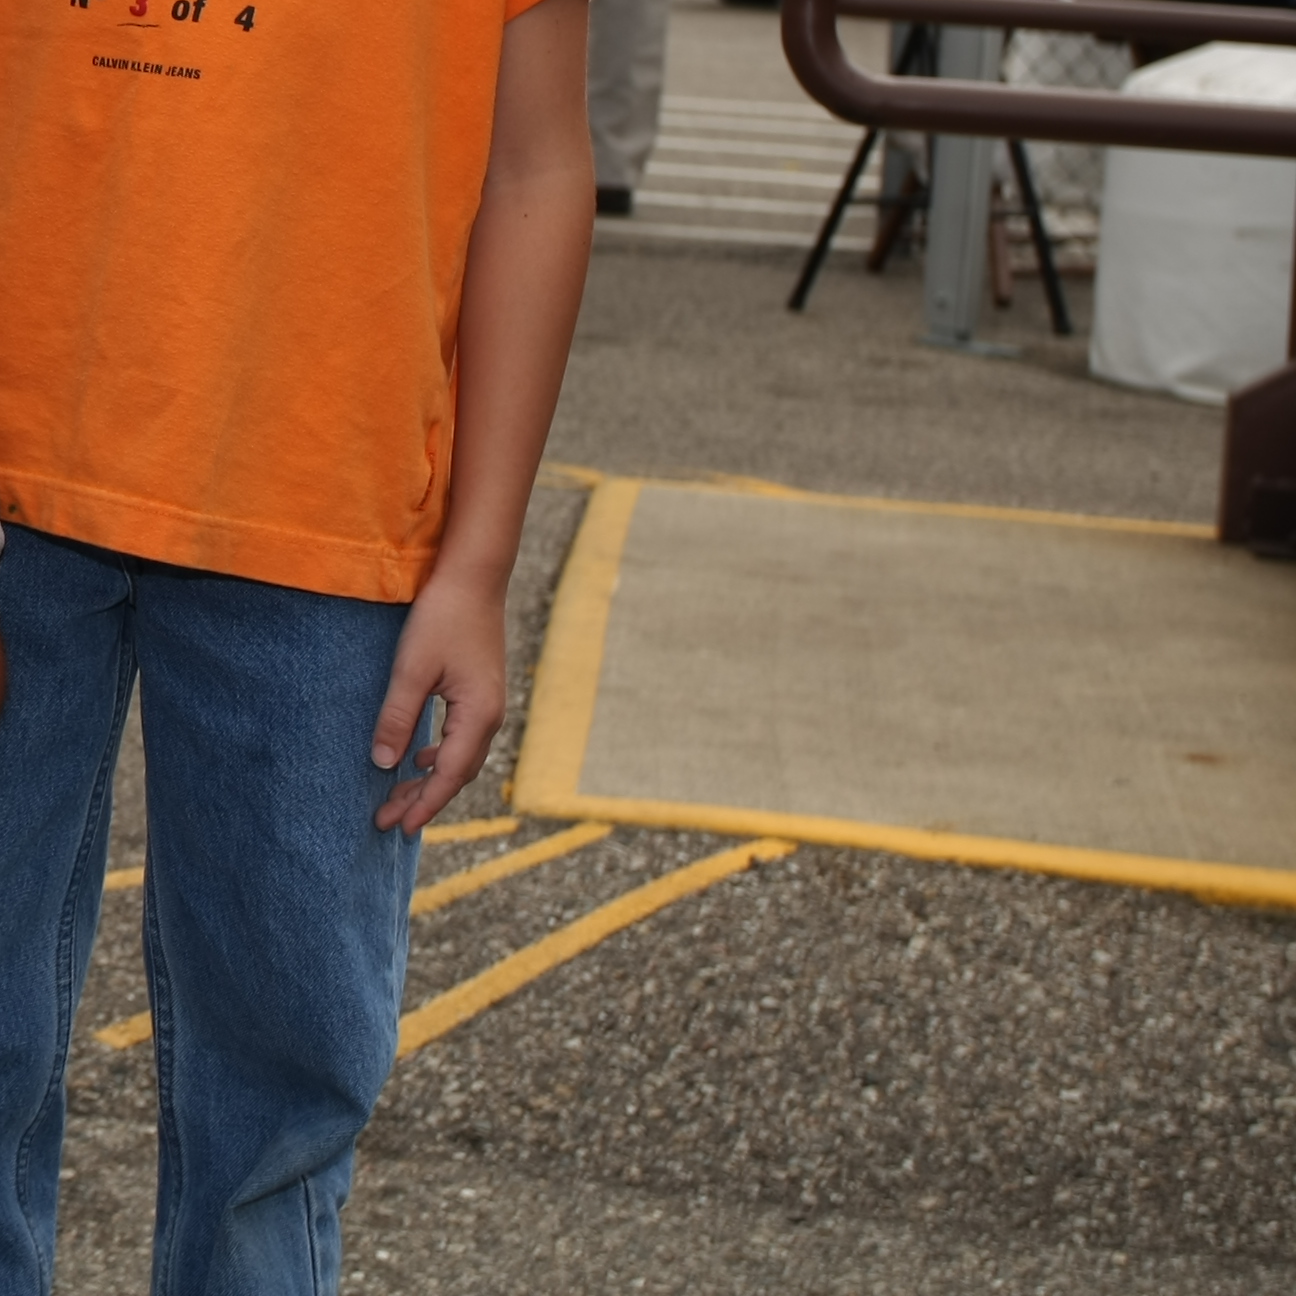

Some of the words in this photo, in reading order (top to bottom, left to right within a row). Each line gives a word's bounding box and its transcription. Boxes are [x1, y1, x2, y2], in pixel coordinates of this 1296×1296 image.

[234, 5, 256, 32] 4
[92, 55, 129, 70] CALVIN
[130, 61, 163, 75] KLEIN
[165, 66, 201, 80] JEANS
